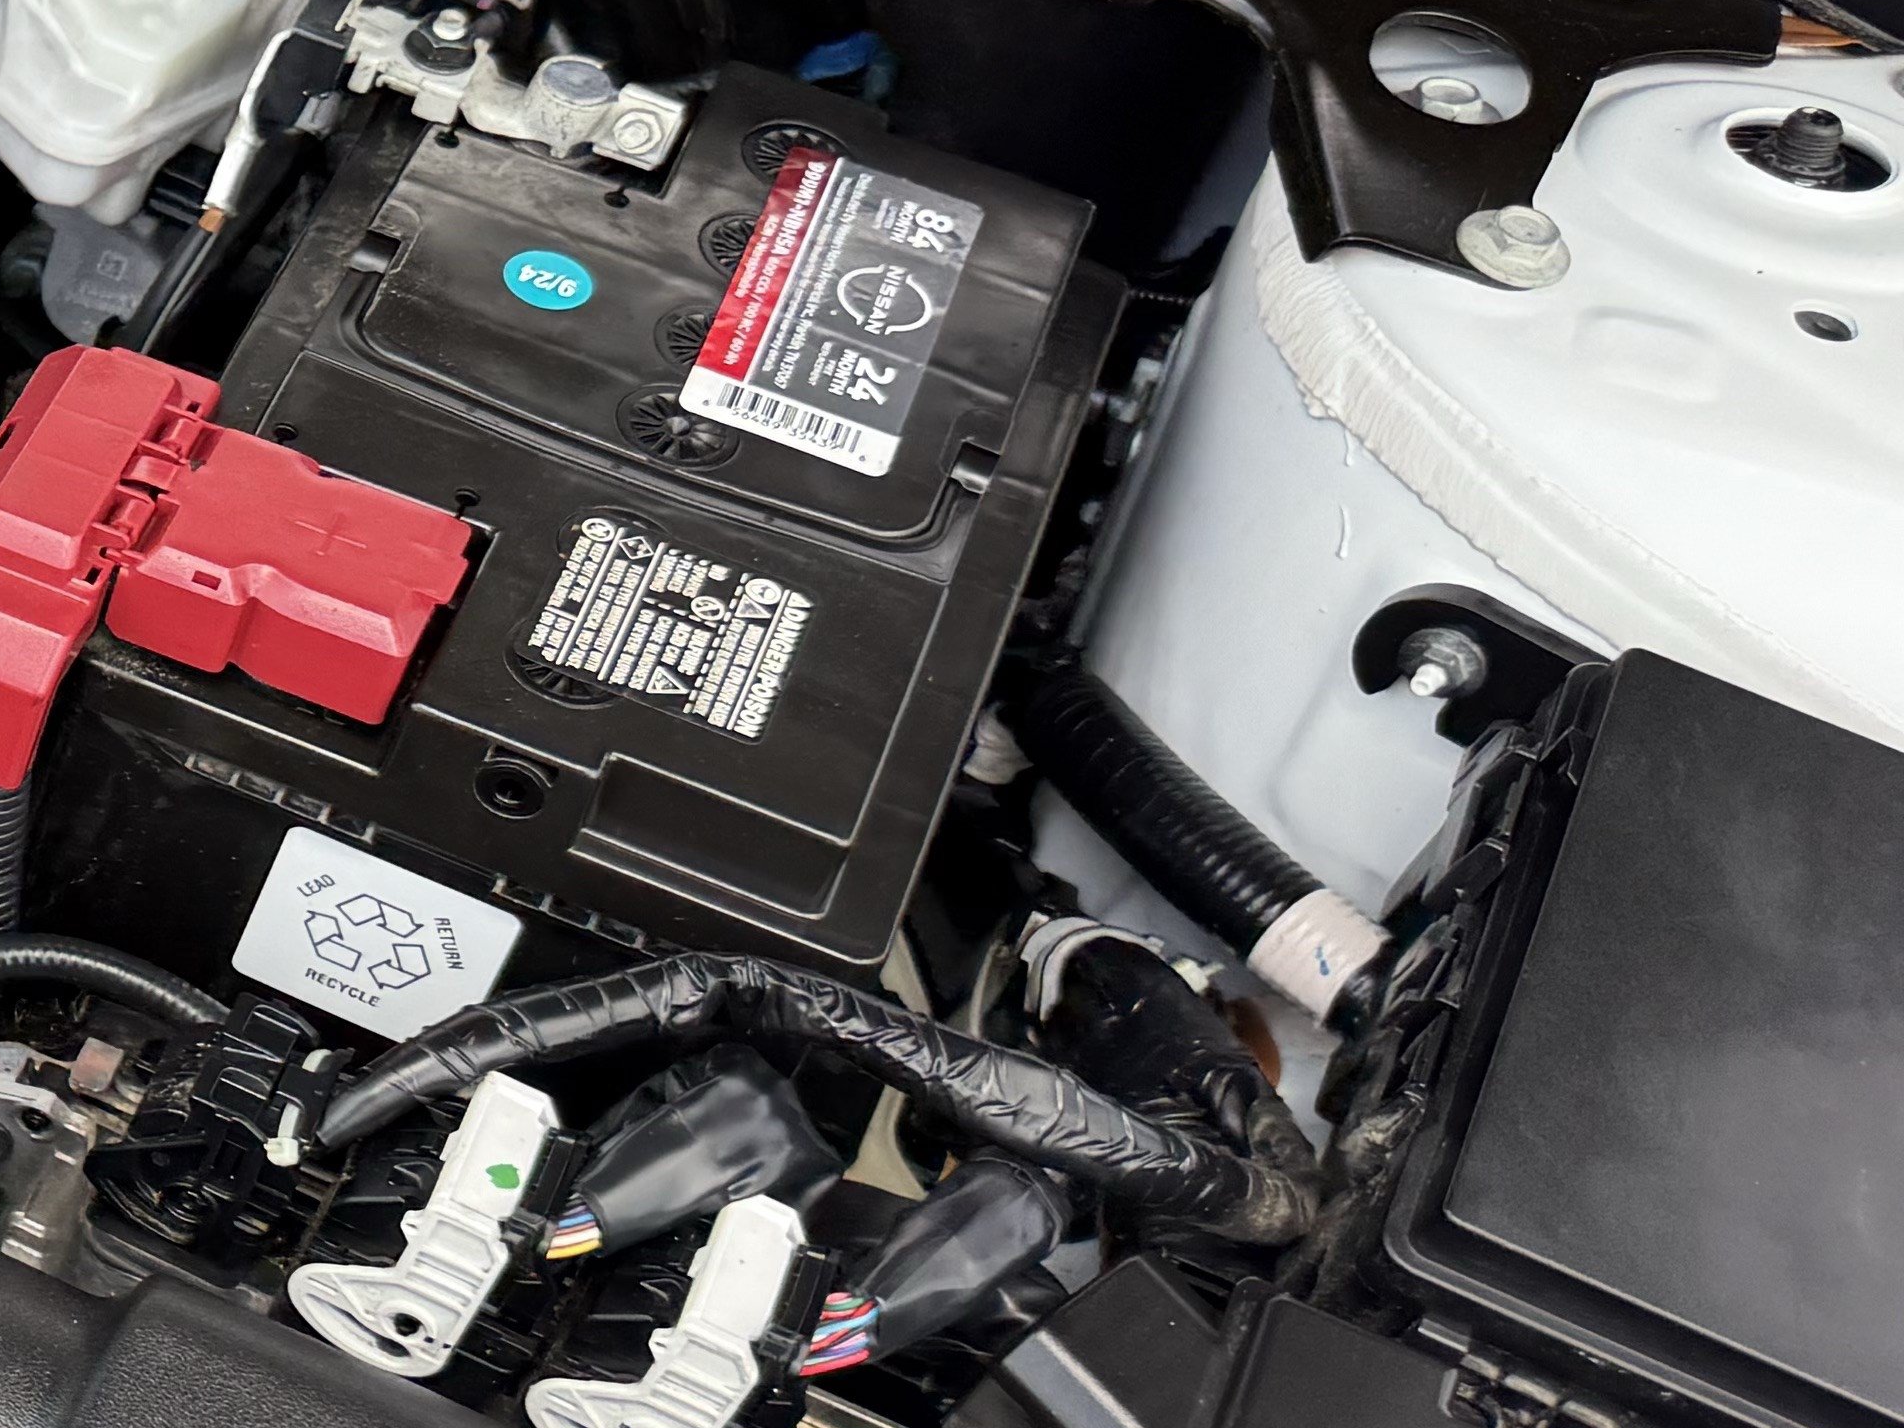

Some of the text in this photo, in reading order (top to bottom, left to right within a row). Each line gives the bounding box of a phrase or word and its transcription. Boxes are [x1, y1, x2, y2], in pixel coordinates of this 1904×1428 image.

[888, 199, 918, 244] MONTH
[904, 206, 957, 256] 84
[517, 263, 579, 298] 9/24
[863, 262, 907, 336] NISSAN
[742, 299, 761, 319] 100
[827, 347, 860, 396] MONTH
[843, 354, 899, 410] 24
[733, 604, 808, 740] DANGER/POISON
[296, 873, 336, 898] LEAD
[433, 916, 465, 970] RETURN
[304, 966, 382, 1008] RECYCLE
